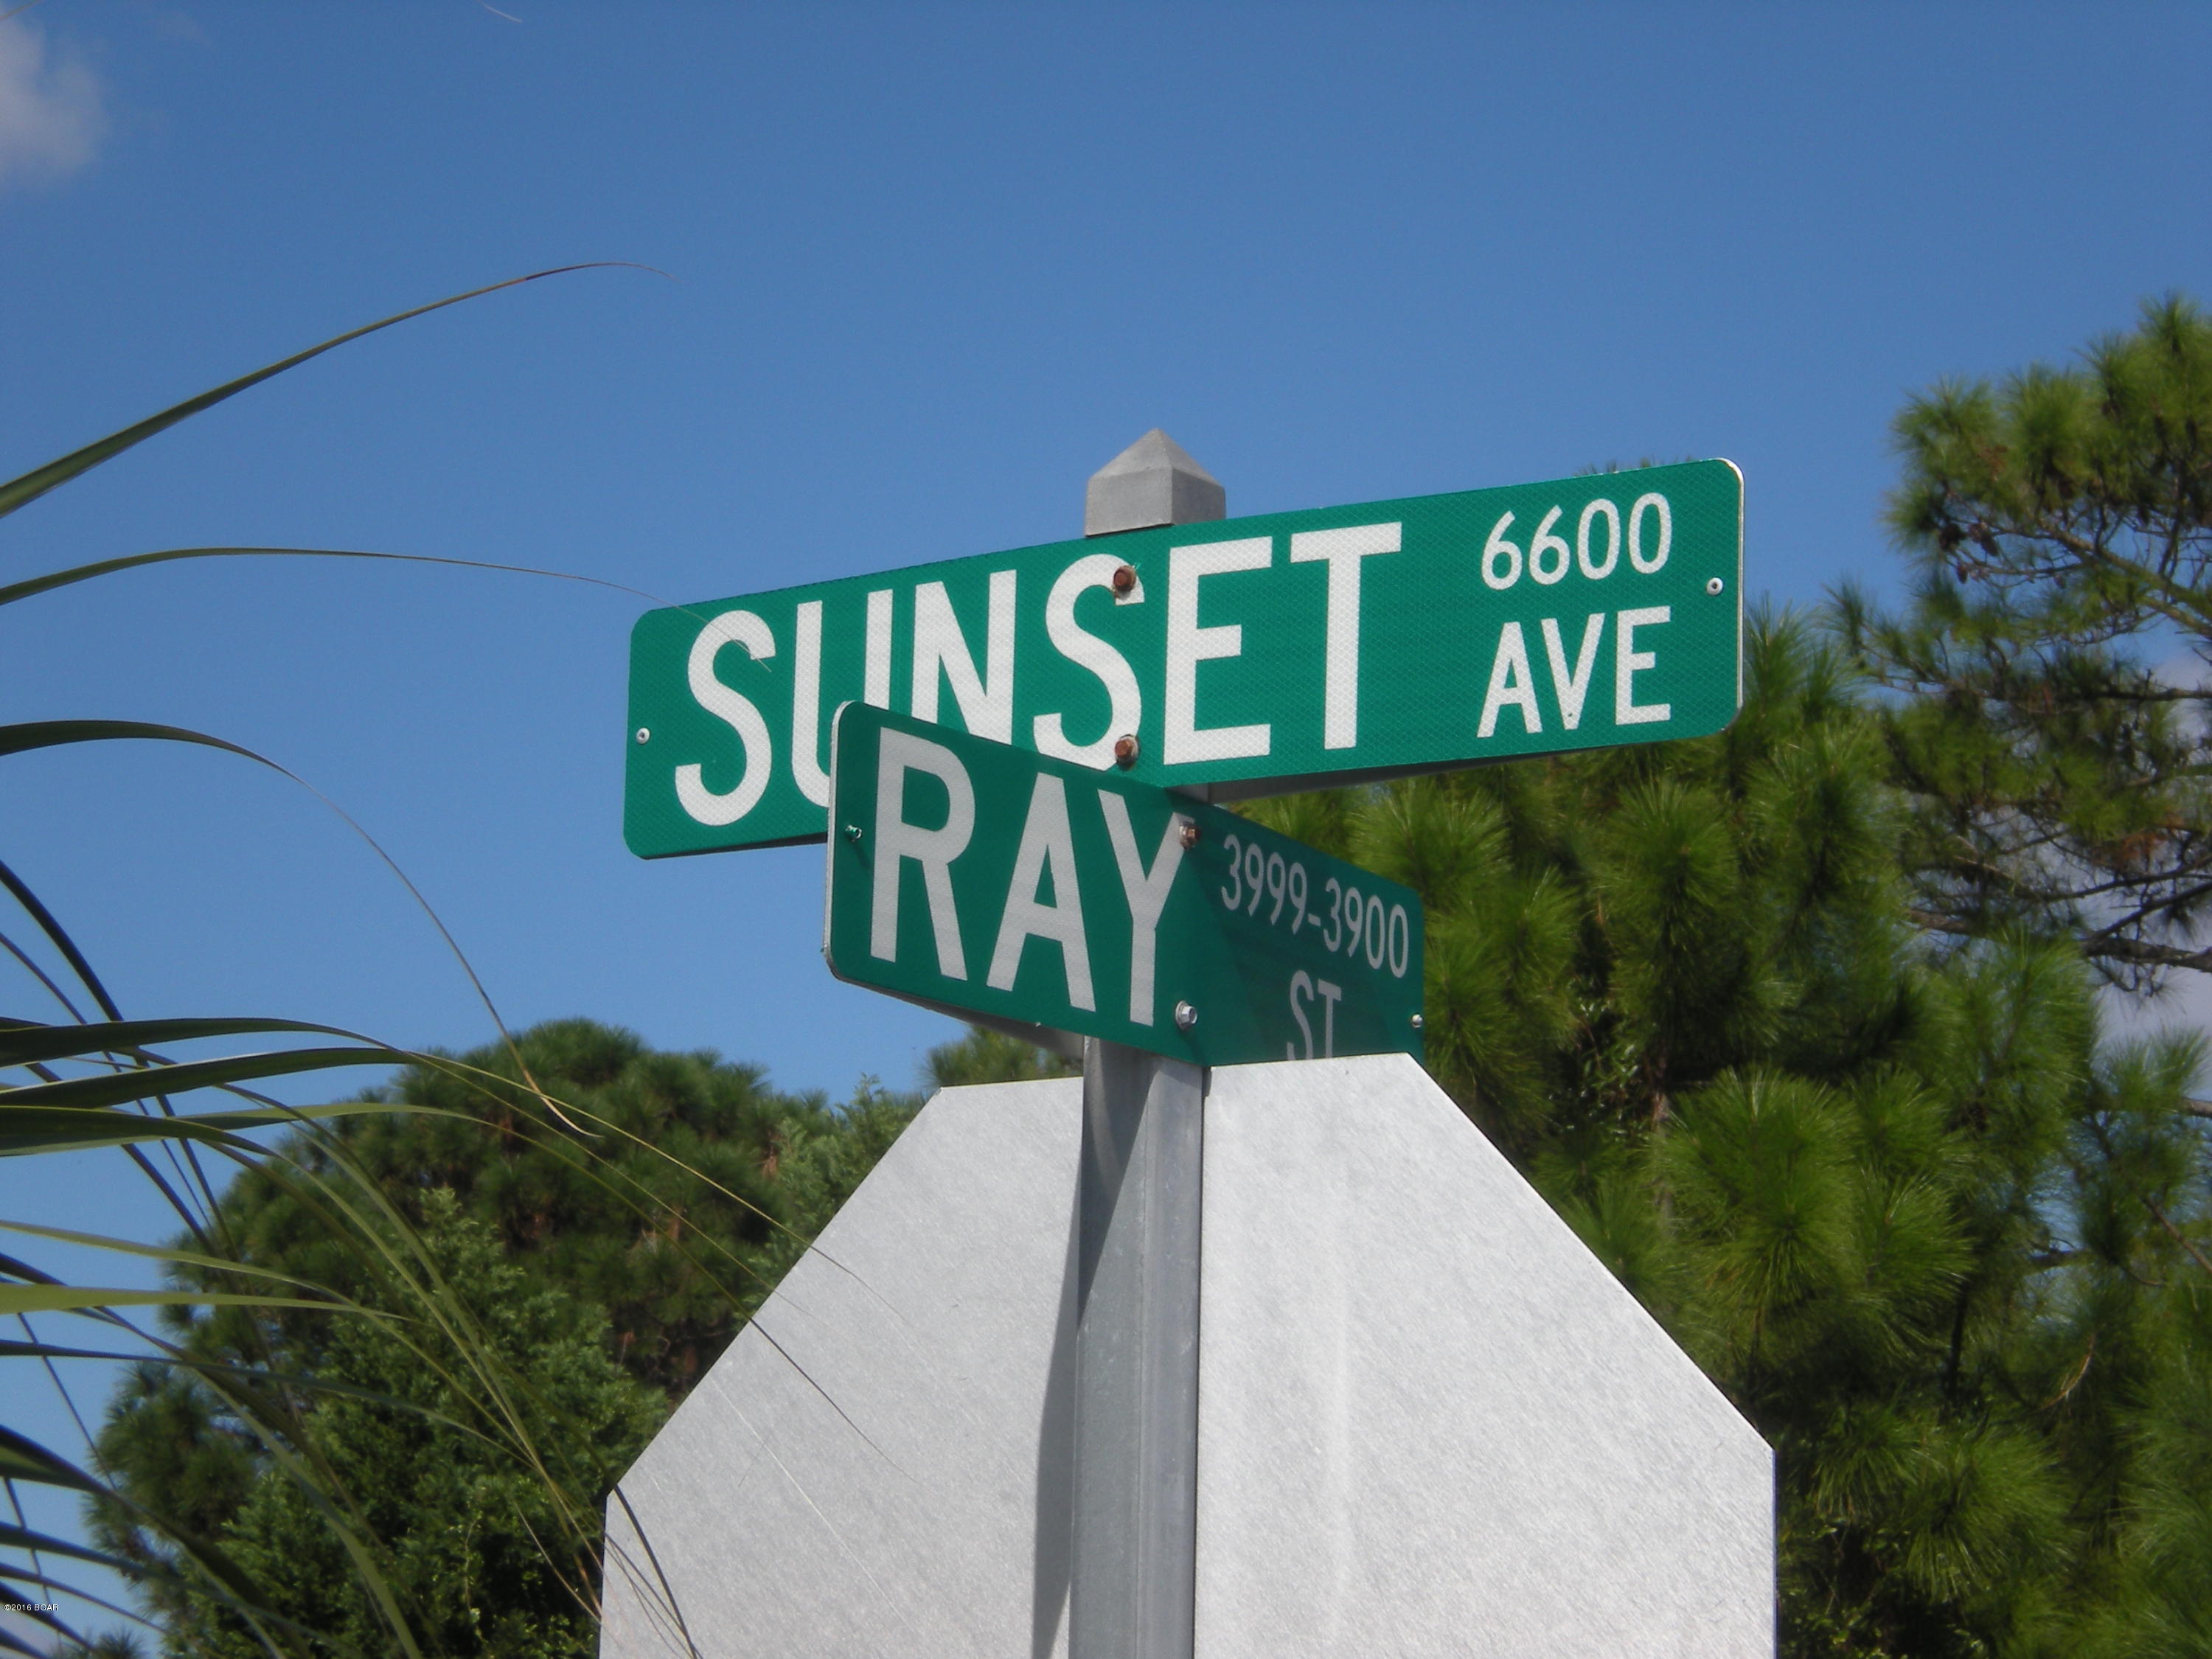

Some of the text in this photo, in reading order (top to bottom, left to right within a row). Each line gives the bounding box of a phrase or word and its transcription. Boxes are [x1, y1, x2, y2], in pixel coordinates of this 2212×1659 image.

[1481, 492, 1672, 590] 6600
[675, 521, 1402, 826] SUNSET
[1477, 605, 1671, 738] AVE
[870, 727, 1194, 1027] RAY
[1221, 834, 1409, 978] 3999-3900
[1286, 970, 1342, 1060] ST
